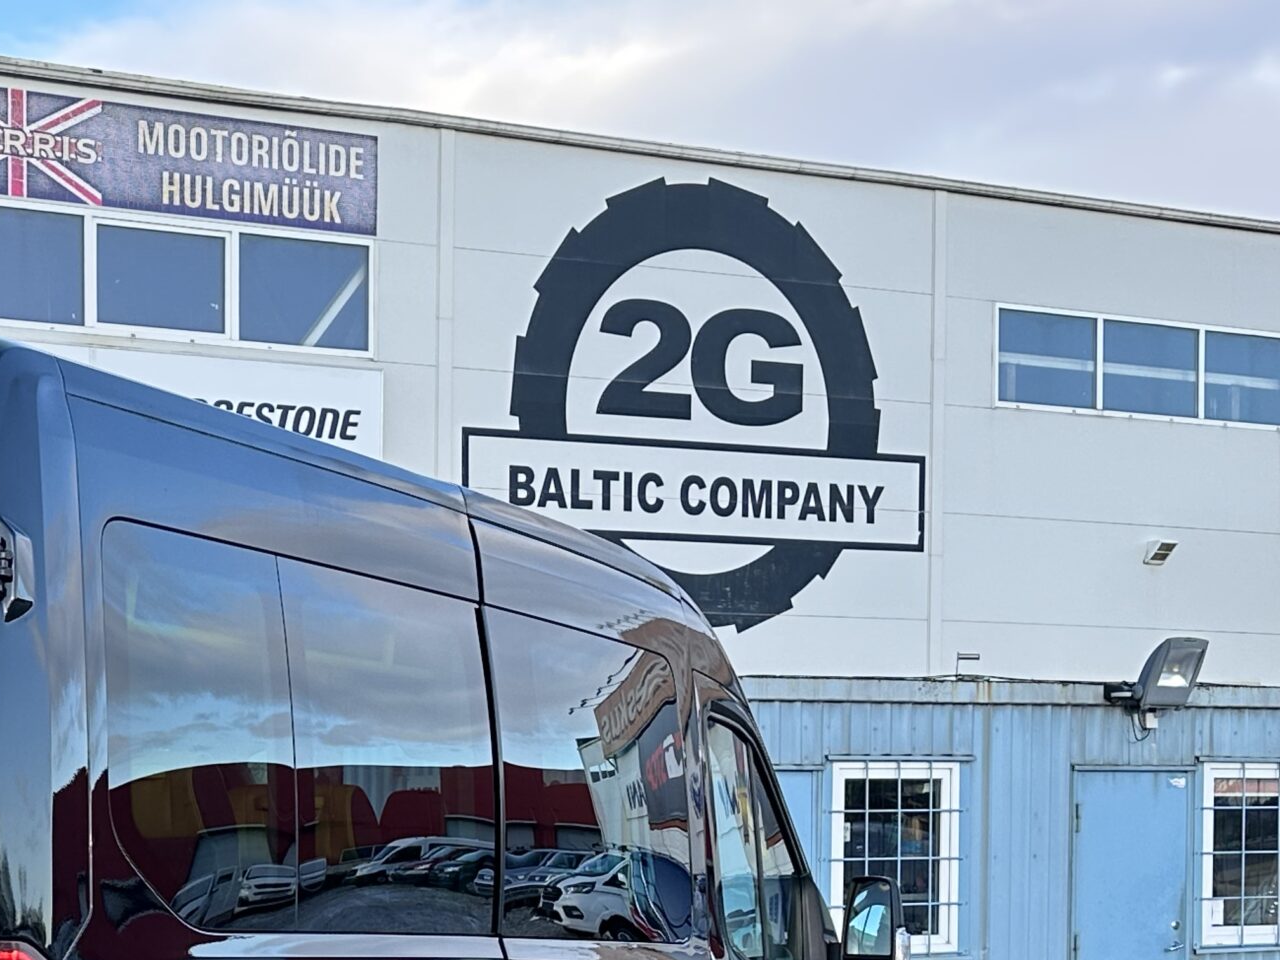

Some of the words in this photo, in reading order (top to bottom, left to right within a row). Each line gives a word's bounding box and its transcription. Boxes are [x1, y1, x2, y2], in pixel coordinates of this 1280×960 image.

[136, 119, 365, 180] MOOTORIÕLIDE
[161, 171, 343, 224] HULGIMÜÜK
[596, 298, 805, 427] 2G
[508, 464, 665, 514] BALTIC
[679, 474, 886, 525] COMPANY
